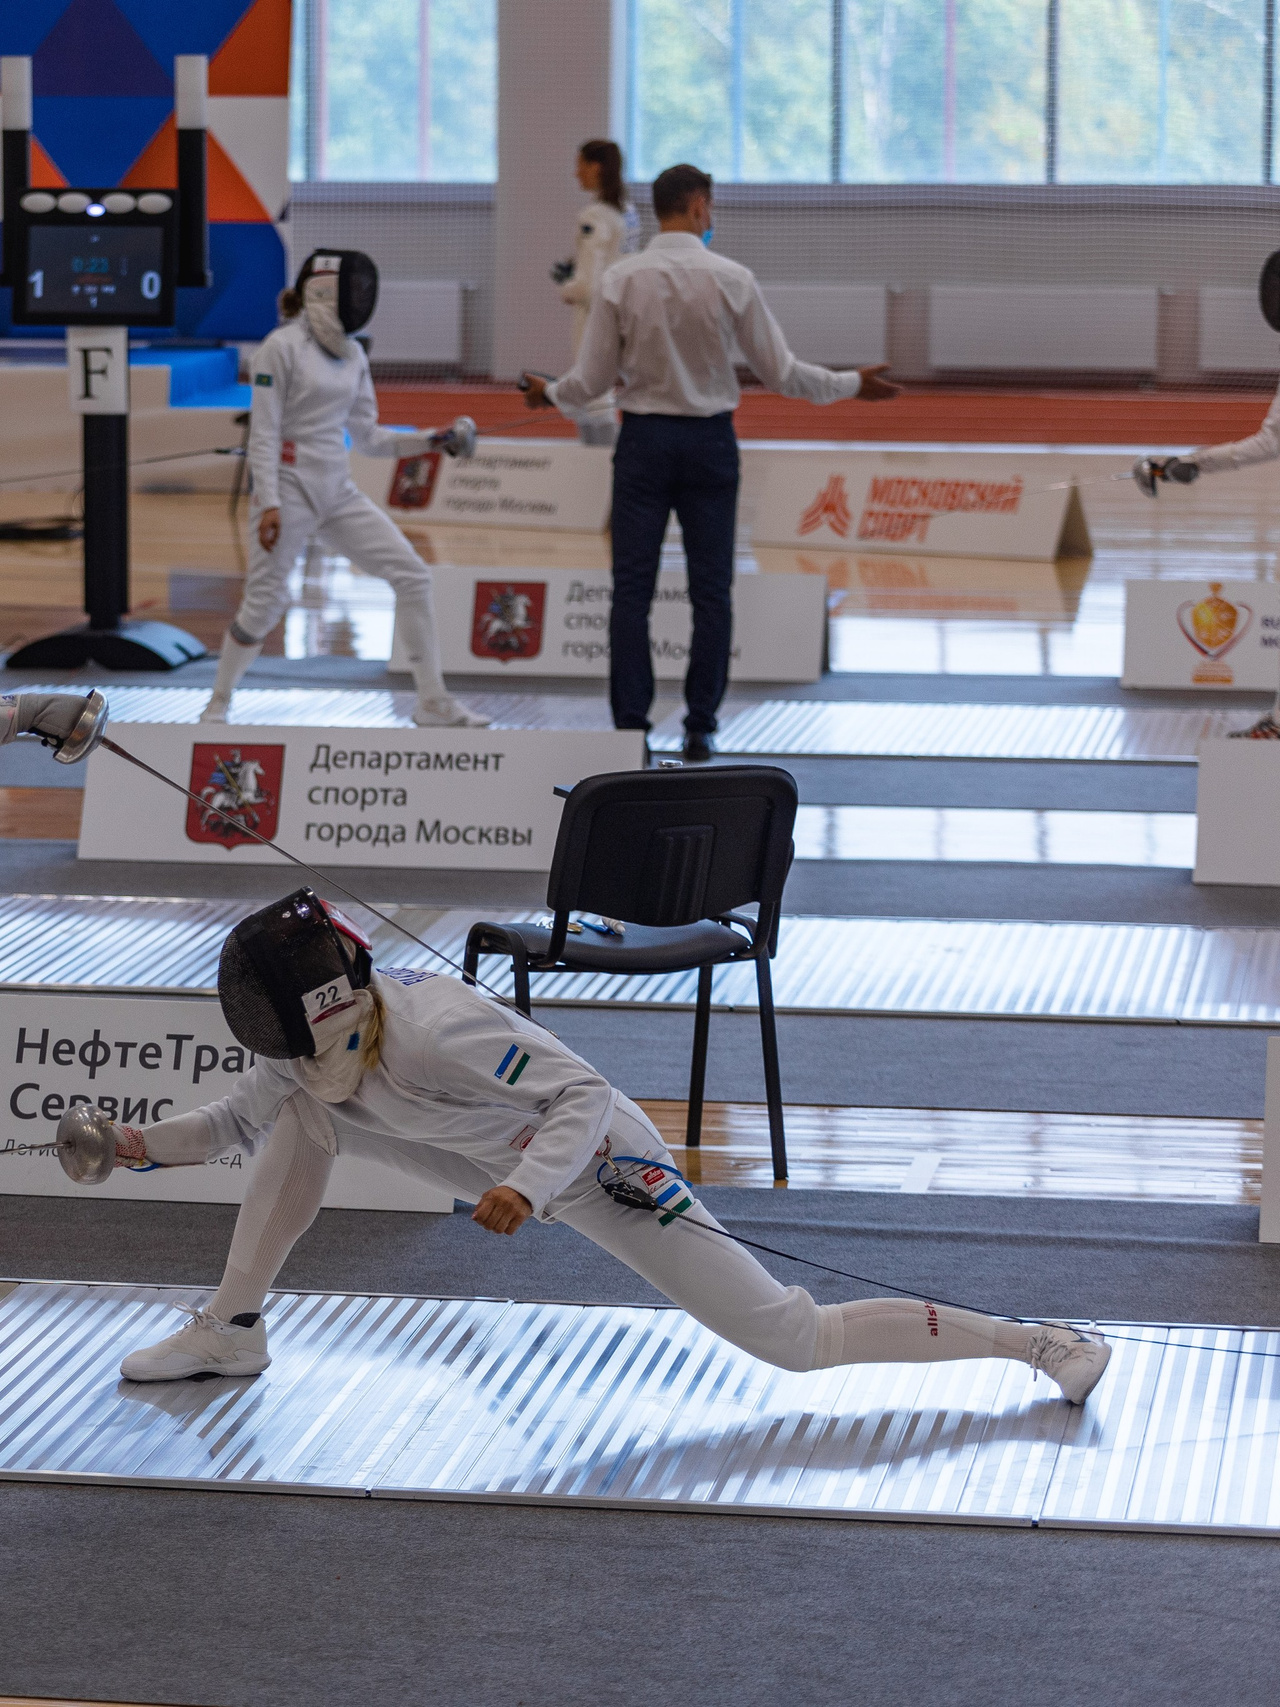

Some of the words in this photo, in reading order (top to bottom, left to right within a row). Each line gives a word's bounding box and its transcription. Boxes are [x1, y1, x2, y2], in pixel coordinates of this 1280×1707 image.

[28, 269, 44, 298] 1
[141, 271, 161, 299] 0
[76, 347, 113, 399] F
[310, 744, 505, 776] Департамент
[307, 786, 408, 812] спорта
[305, 822, 407, 848] города
[416, 818, 533, 846] Москвы
[315, 985, 342, 1010] 22
[15, 1027, 255, 1084] НефтеТра
[9, 1082, 174, 1125] Севис
